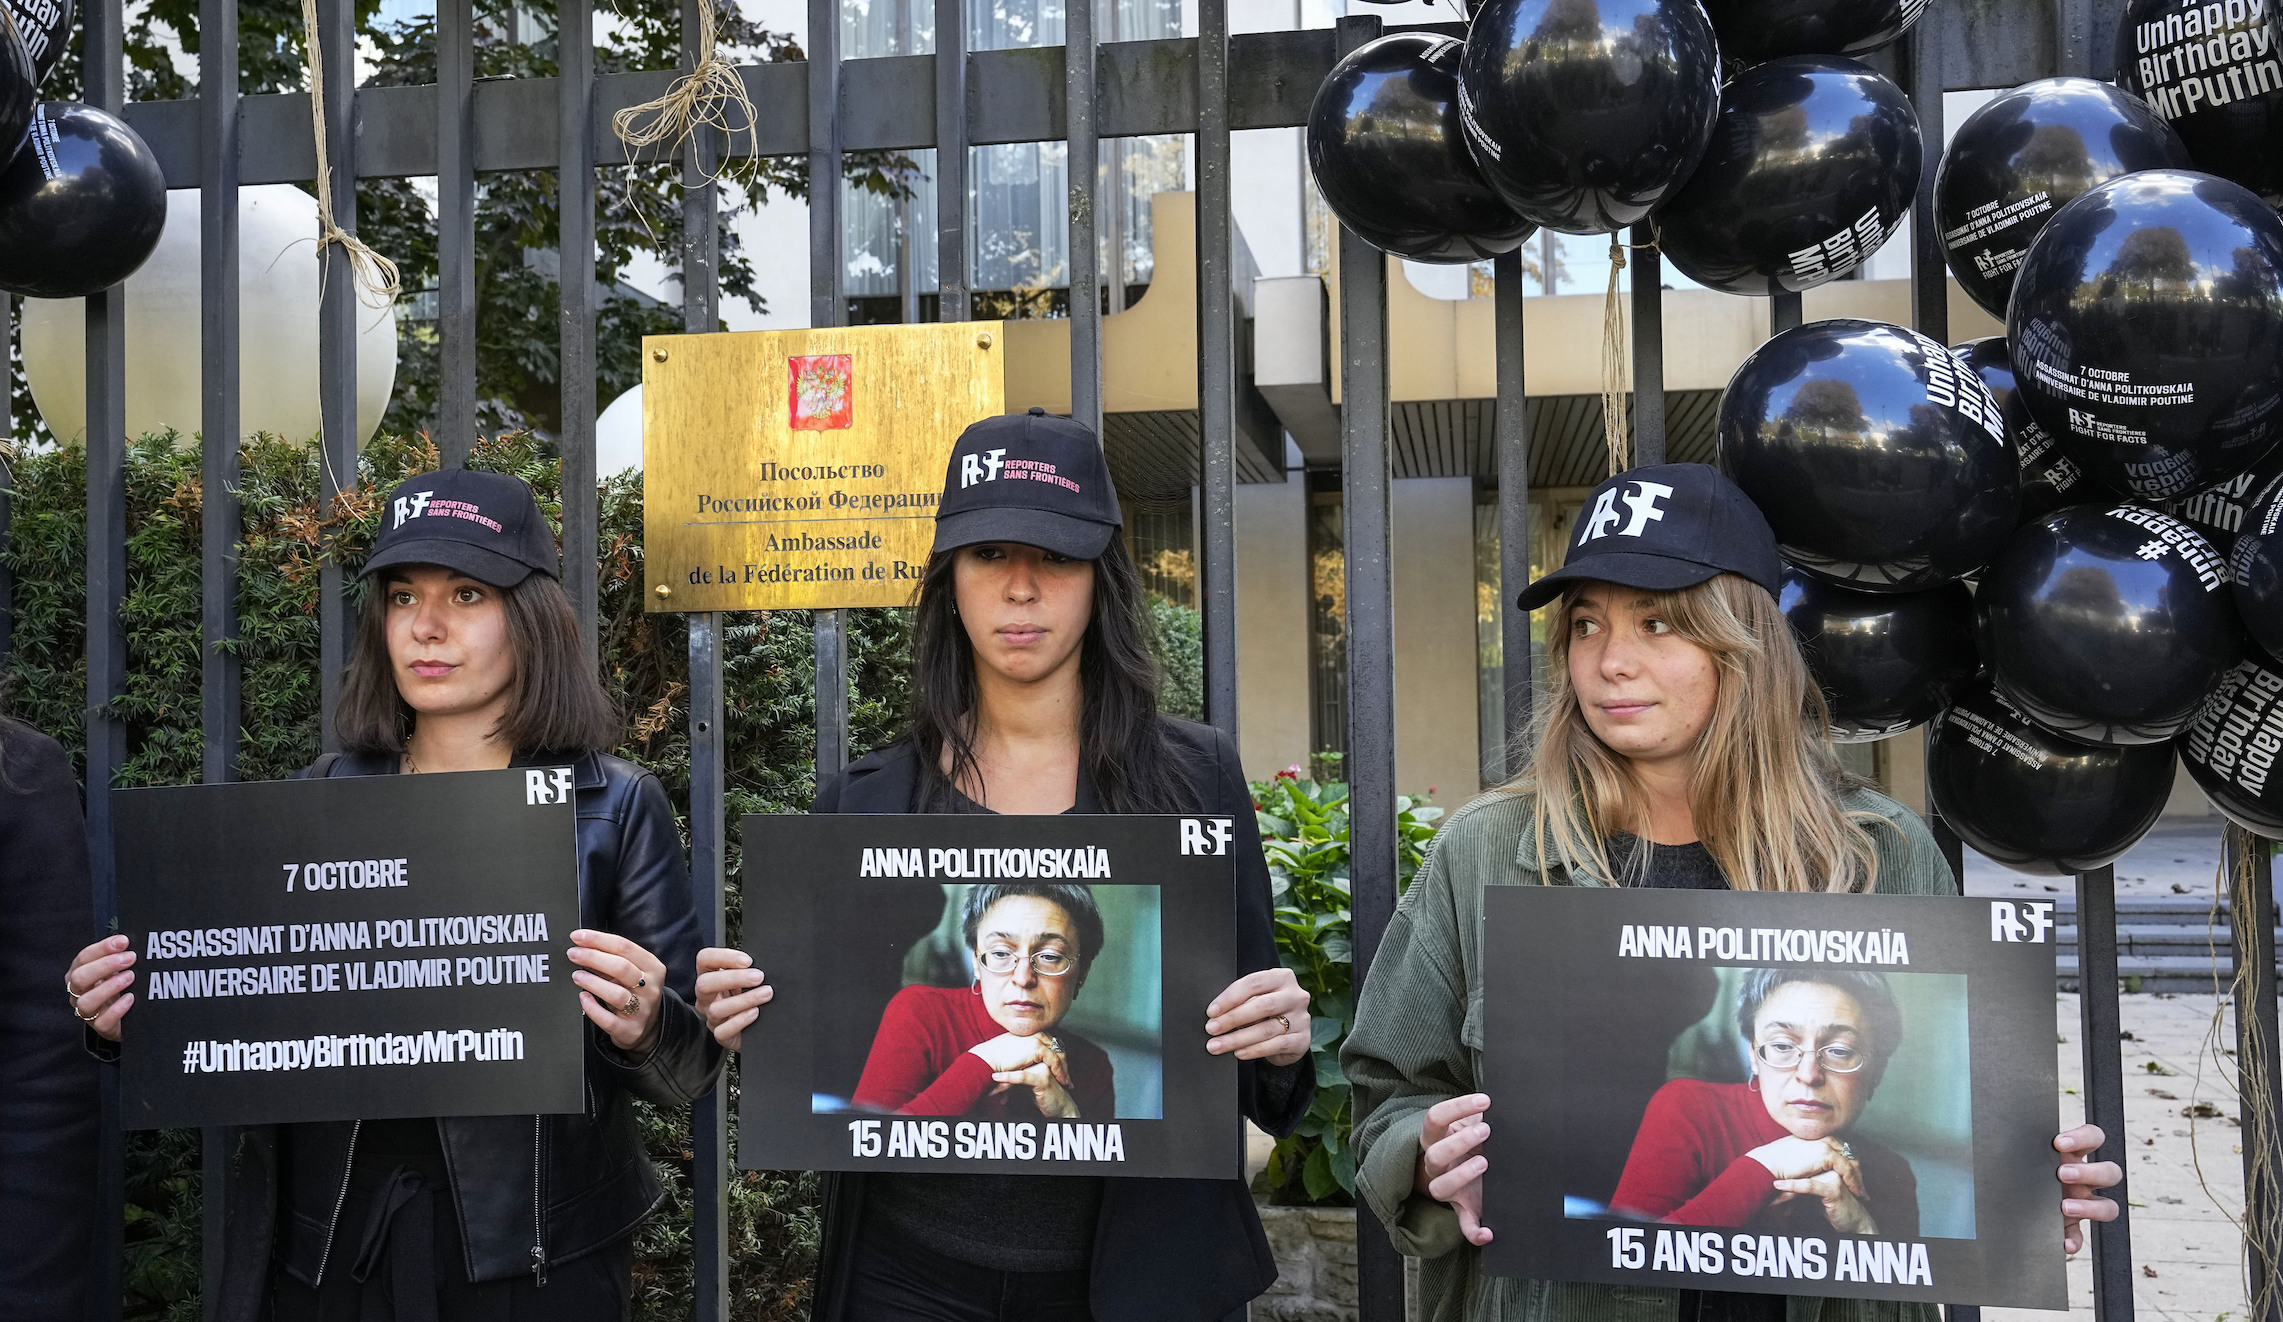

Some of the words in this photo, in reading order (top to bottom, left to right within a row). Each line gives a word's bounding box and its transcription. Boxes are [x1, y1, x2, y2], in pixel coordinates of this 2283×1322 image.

[2137, 0, 2264, 54] Unhappy
[2139, 25, 2269, 89] Birthday
[2145, 59, 2283, 120] MrPutin
[1966, 212, 1971, 220] 7
[1971, 200, 1999, 218] OCTOBRE
[1978, 229, 1988, 238] DE
[1986, 215, 2019, 235] VLADIMIR
[2019, 200, 2052, 221] POUTINE
[1992, 191, 2048, 221] POLITKOVSKAIA
[2035, 370, 2086, 399] ANNIVERSAIRE
[2088, 390, 2100, 401] DE
[2102, 393, 2147, 406] VLADIMIR
[2150, 394, 2194, 406] POUTINE
[2036, 359, 2079, 385] ASSASSINAT
[2081, 378, 2112, 393] D'ANNA
[2115, 382, 2193, 395] POLITKOVSKAIA
[2080, 365, 2086, 375] 7
[2088, 367, 2130, 382] OCTOBRE
[2068, 407, 2095, 429] RSF
[2070, 424, 2095, 438] FIGHT
[2096, 431, 2115, 442] FOR
[2117, 434, 2147, 444] FACTS
[760, 462, 884, 482] Посольство
[961, 448, 1006, 489] RSF
[1005, 460, 1056, 474] REPORTERS
[2020, 446, 2045, 470] RSAIRE
[2044, 458, 2071, 486] RSF
[1003, 470, 1028, 480] SANS
[2056, 473, 2077, 493] FIGHT
[393, 490, 434, 530] RSF
[430, 500, 479, 514] REPORTERS
[427, 508, 450, 517] SANS
[697, 491, 821, 514] Российской
[1577, 480, 1674, 547] RSF
[2260, 504, 2276, 535] POUTINE
[764, 530, 882, 552] Ambassade
[2105, 508, 2220, 592] Unhappy
[2136, 540, 2171, 560] #
[689, 566, 713, 585] de
[718, 565, 736, 584] la
[743, 562, 855, 584] Fédération
[861, 562, 886, 580] de
[1993, 725, 2004, 735] DE
[2209, 669, 2283, 781] Birthday
[1967, 734, 1993, 753] OCTOBRE
[1992, 748, 1998, 756] 7
[2002, 742, 2042, 770] ASSASSINAT
[526, 768, 572, 805] RSF
[1180, 818, 1233, 856] RSF
[283, 864, 300, 892] 7
[304, 858, 408, 891] OCTOBRE
[860, 847, 924, 878] ANNA
[929, 847, 1111, 879] POLITKOVSKAÏA
[146, 925, 284, 960] ASSASSINAT
[290, 920, 371, 954] D'ANNA
[376, 913, 549, 947] POLITKOVSKAÏA
[1991, 901, 2054, 944] RSF
[1618, 924, 1693, 959] ANNA
[1698, 926, 1909, 965] POLITKOVSKAÏA
[148, 964, 306, 1000] ANNIVERSAIRE
[311, 962, 340, 993] DE
[344, 957, 451, 991] VLADIMIR
[456, 954, 550, 986] POUTINE
[182, 1027, 524, 1073] #UnhappyBirthdayMrPutin
[848, 1120, 882, 1158] 15
[886, 1121, 950, 1159] ANS
[954, 1122, 1037, 1160] SANS
[1041, 1123, 1125, 1162] ANNA
[1606, 1227, 1646, 1269] 15
[1652, 1230, 1724, 1274] ANS
[1731, 1233, 1827, 1281] SANS
[1834, 1240, 1933, 1286] ANNA
